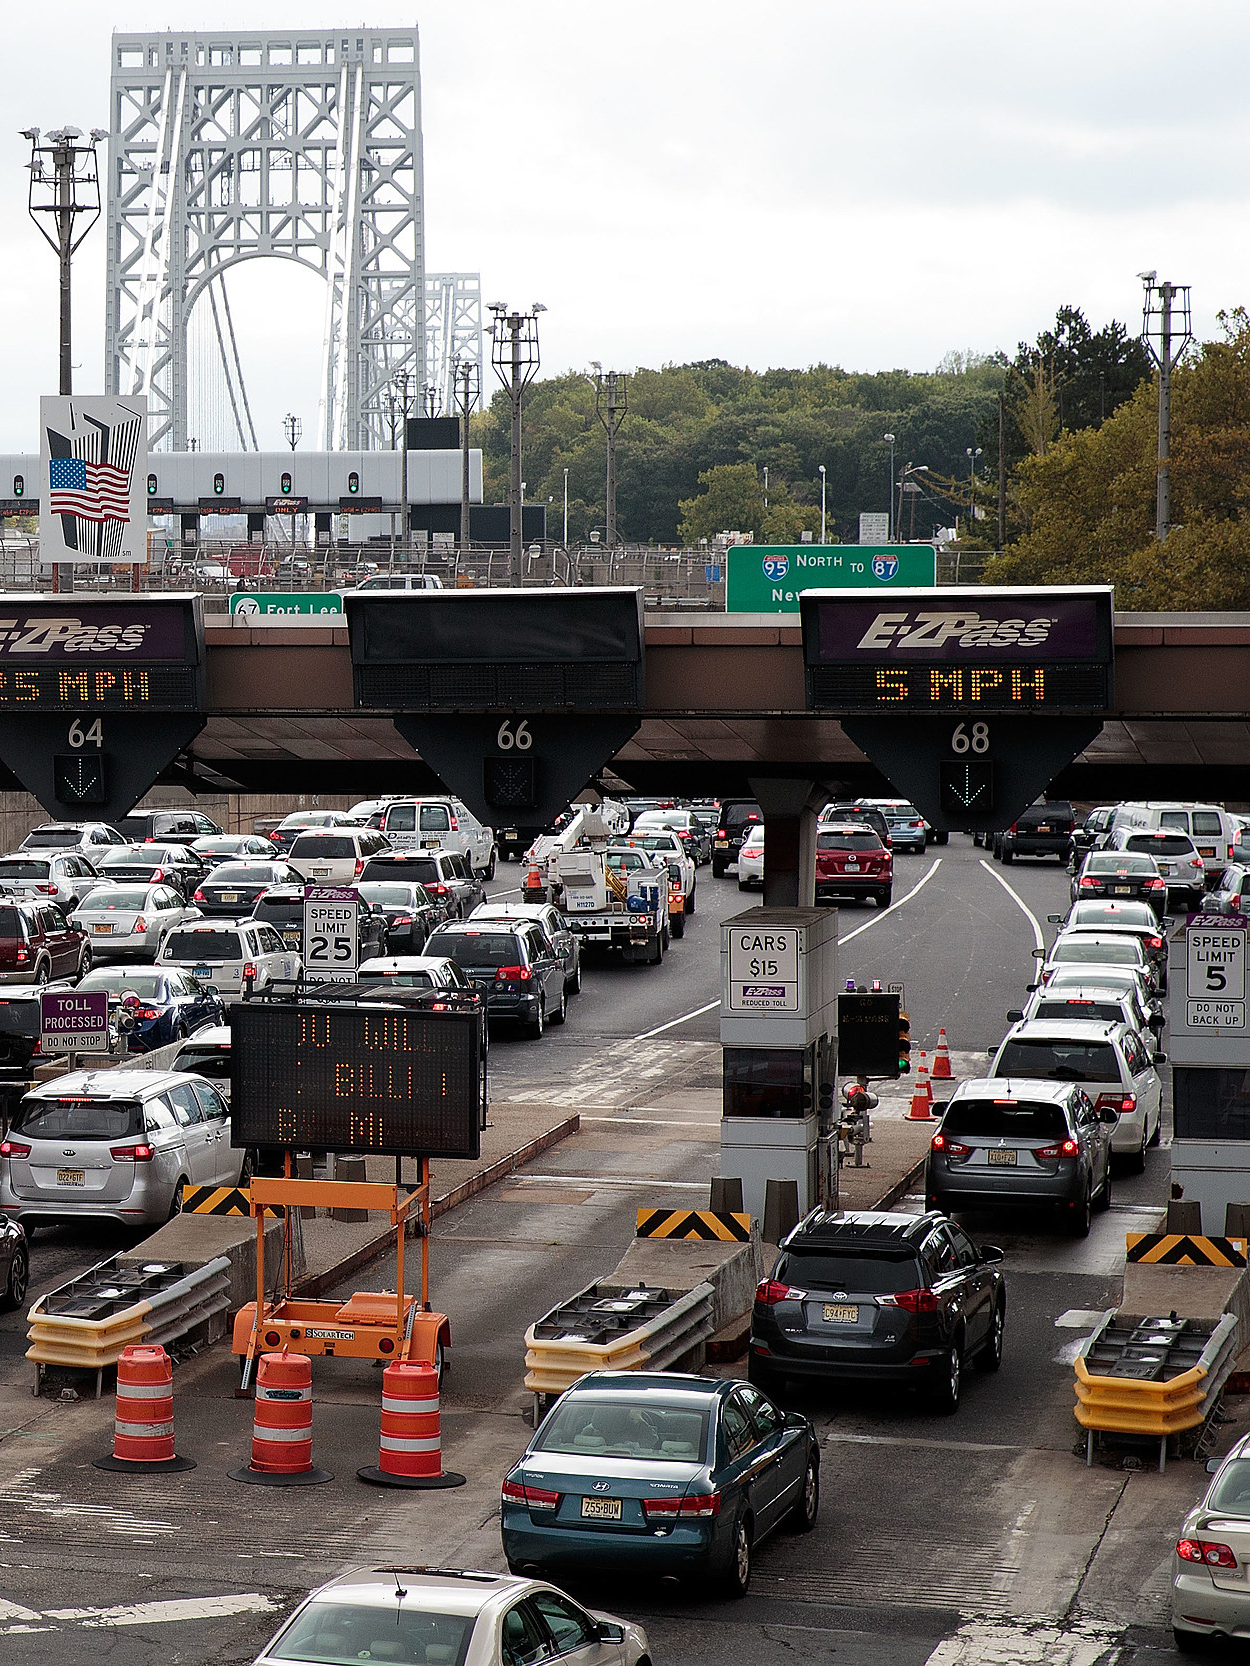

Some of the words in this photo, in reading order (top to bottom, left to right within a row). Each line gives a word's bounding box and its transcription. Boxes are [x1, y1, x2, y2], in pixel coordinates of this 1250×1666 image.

[764, 561, 787, 576] 95
[796, 554, 842, 567] NORTH
[850, 563, 865, 573] TO
[875, 561, 896, 576] 87
[267, 605, 301, 614] Fort
[310, 604, 338, 614] Lee
[856, 612, 1053, 649] E-ZPass
[59, 671, 150, 701] MPH
[876, 670, 909, 700] 5
[930, 670, 1045, 701] MPH
[69, 719, 103, 748] 64
[497, 720, 532, 750] 66
[951, 722, 989, 754] 68
[308, 887, 355, 899] E-ZPass
[310, 908, 352, 920] SPEED
[315, 922, 348, 934] LIMIT
[1190, 915, 1244, 928] E-ZPass
[740, 935, 787, 952] CARS
[1192, 936, 1241, 948] SPEED
[309, 936, 353, 962] 25
[1196, 951, 1236, 963] LIMIT
[749, 957, 778, 978] $15
[1206, 965, 1227, 991] 5
[744, 987, 784, 996] E-ZPass
[58, 999, 92, 1011] TOLL
[742, 1000, 768, 1008] REDUCED
[770, 1000, 787, 1008] TOLL
[1196, 1003, 1211, 1013] DO
[1216, 1003, 1236, 1014] NOT
[45, 1015, 104, 1030] PROCESSED
[1192, 1015, 1219, 1026] BACK
[1225, 1016, 1239, 1025] UP
[48, 1037, 59, 1047] DO
[63, 1036, 78, 1046] NOT
[81, 1035, 101, 1046] STOP
